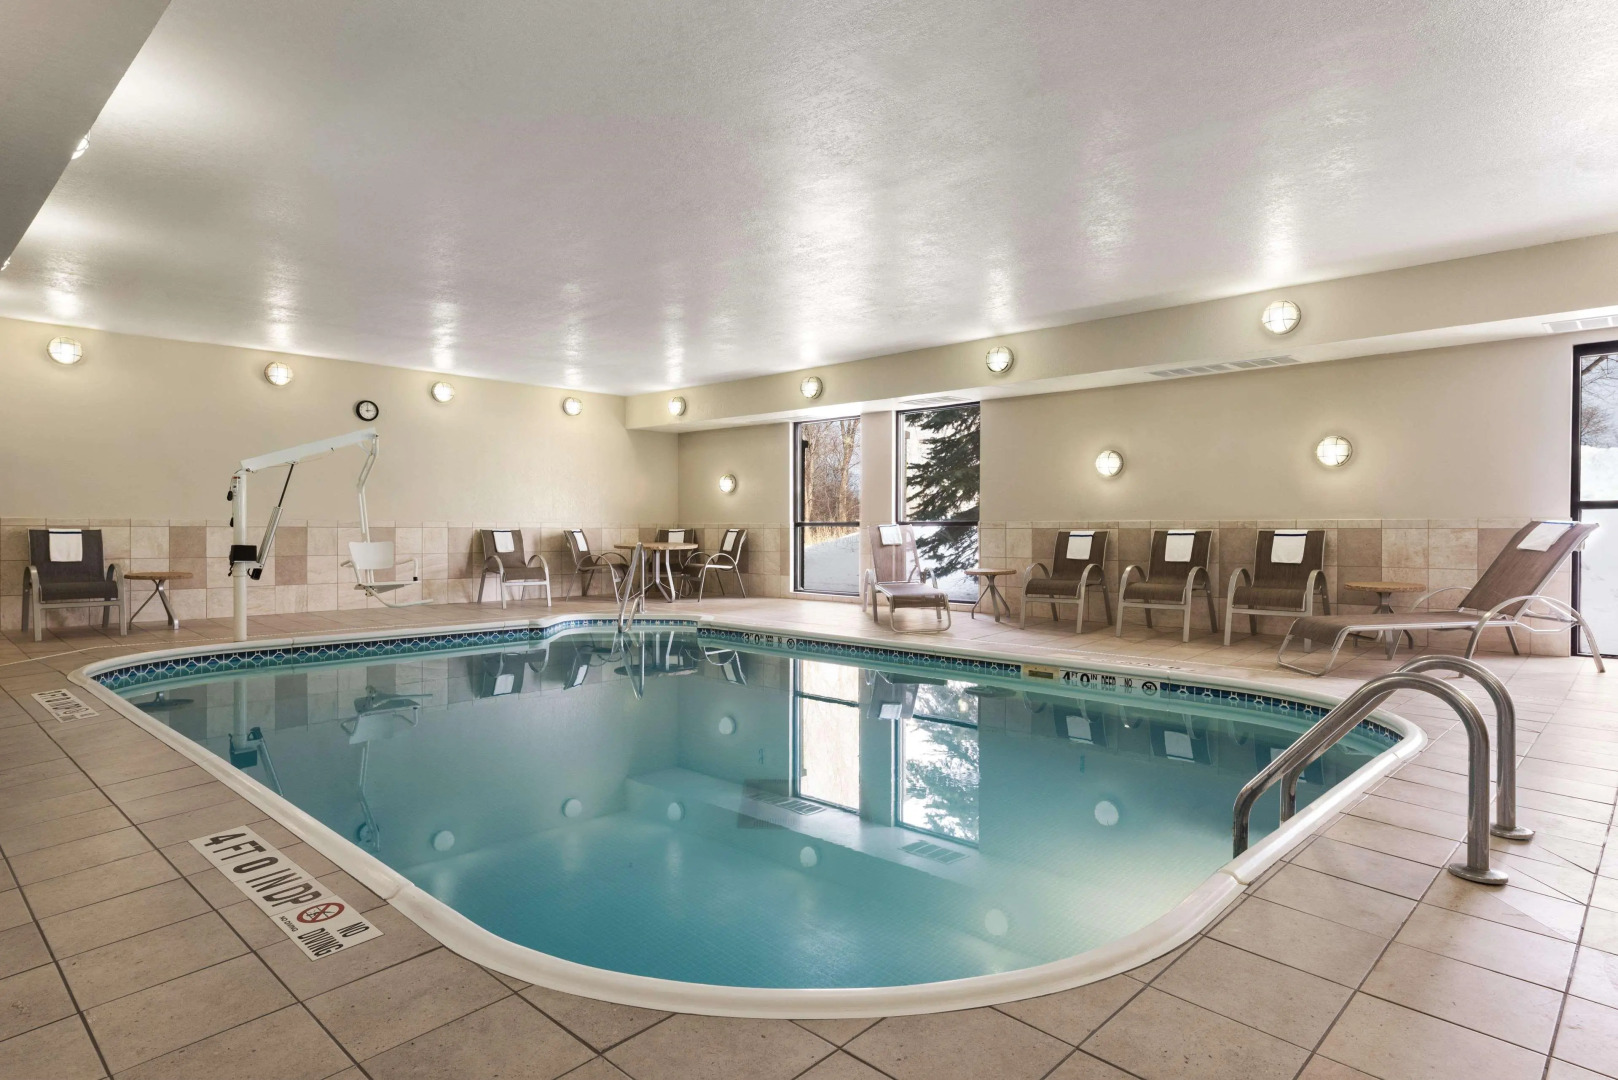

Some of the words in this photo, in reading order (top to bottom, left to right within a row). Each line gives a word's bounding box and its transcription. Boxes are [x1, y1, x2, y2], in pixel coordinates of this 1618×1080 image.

[1090, 673, 1098, 681] IN
[1124, 678, 1133, 687] NO
[204, 832, 247, 847] 4
[212, 840, 267, 861] FT
[245, 868, 303, 893] IN
[262, 882, 323, 907] DP
[336, 921, 370, 938] NO
[297, 927, 344, 957] DIVING
